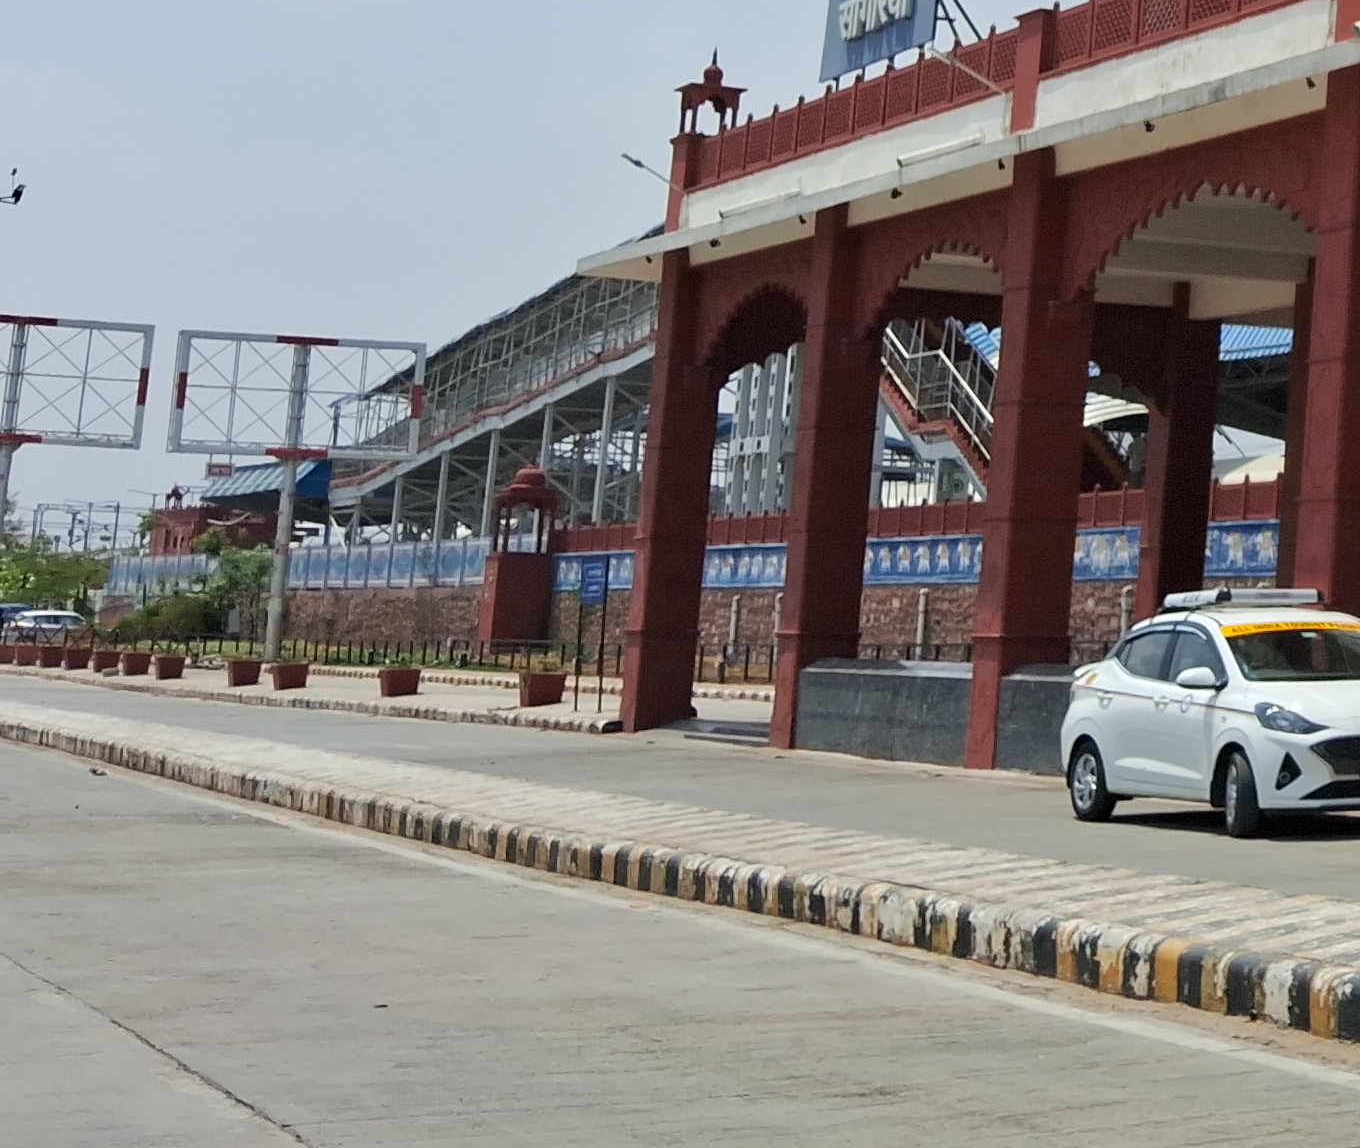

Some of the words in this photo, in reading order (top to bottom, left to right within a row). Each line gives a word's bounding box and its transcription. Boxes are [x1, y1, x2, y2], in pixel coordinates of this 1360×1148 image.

[1231, 626, 1252, 634] ALL
[1254, 623, 1279, 631] INDIA
[1284, 622, 1326, 630] TOURIST
